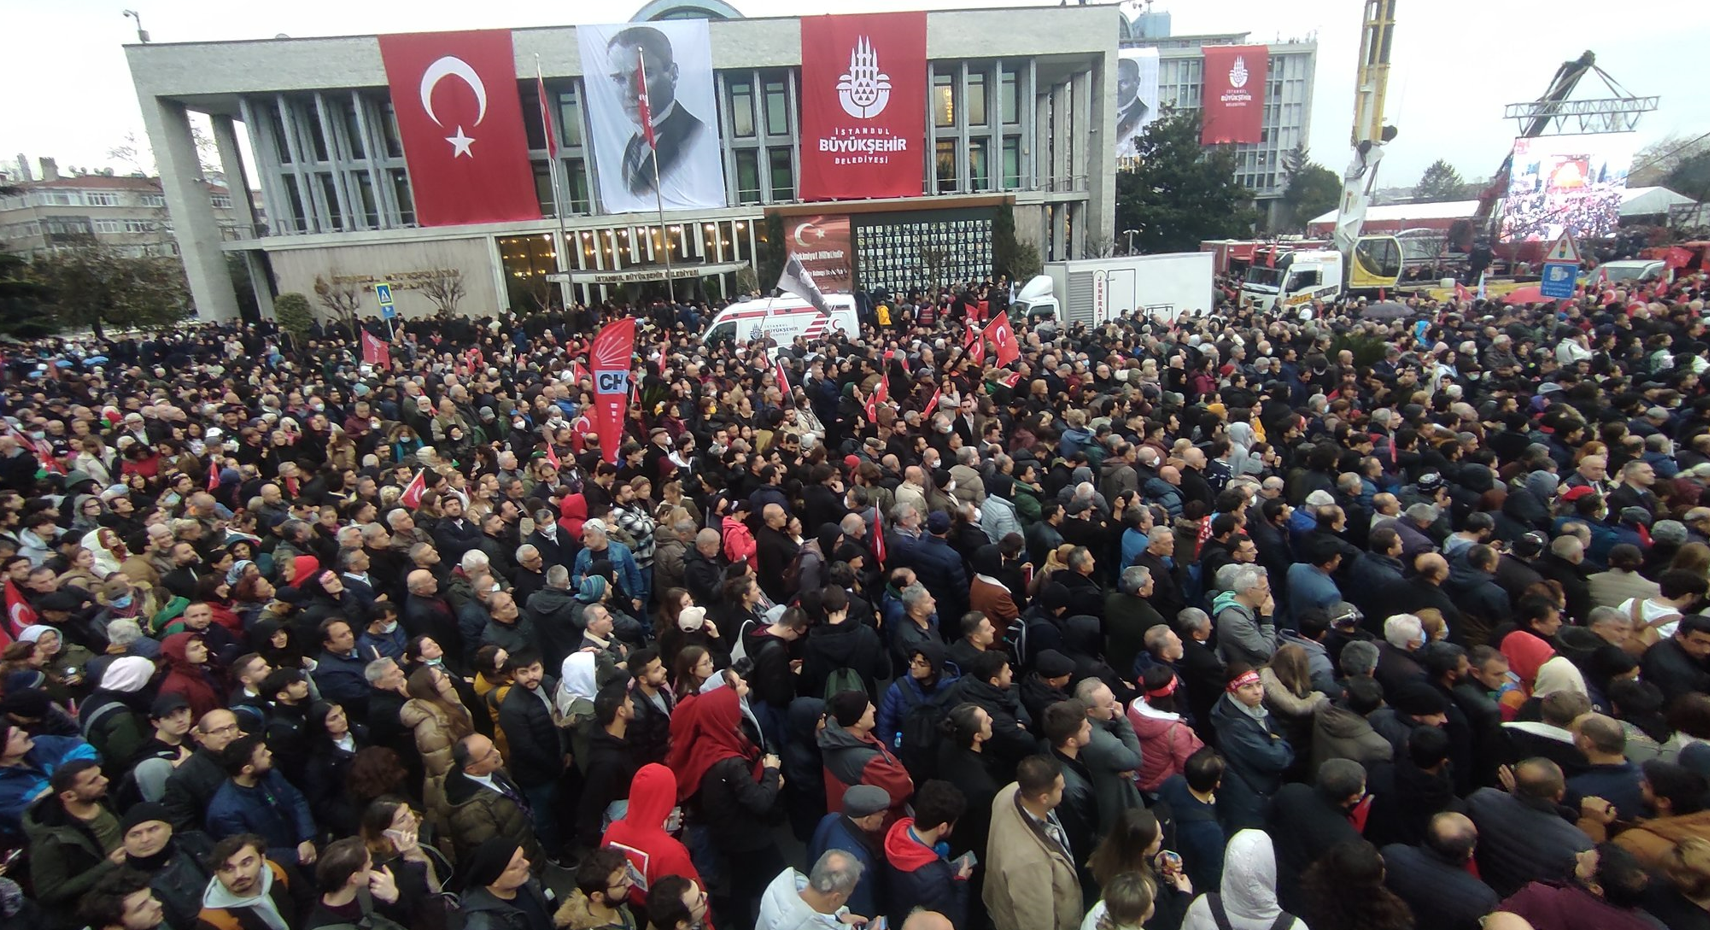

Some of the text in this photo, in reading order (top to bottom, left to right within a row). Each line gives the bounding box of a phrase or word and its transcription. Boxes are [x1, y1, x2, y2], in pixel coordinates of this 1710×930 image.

[835, 127, 890, 136] İSTANBUL
[819, 136, 907, 154] BÜYÜKŞEHİR
[835, 155, 888, 165] BELEDİYESİ
[599, 373, 624, 391] CH
